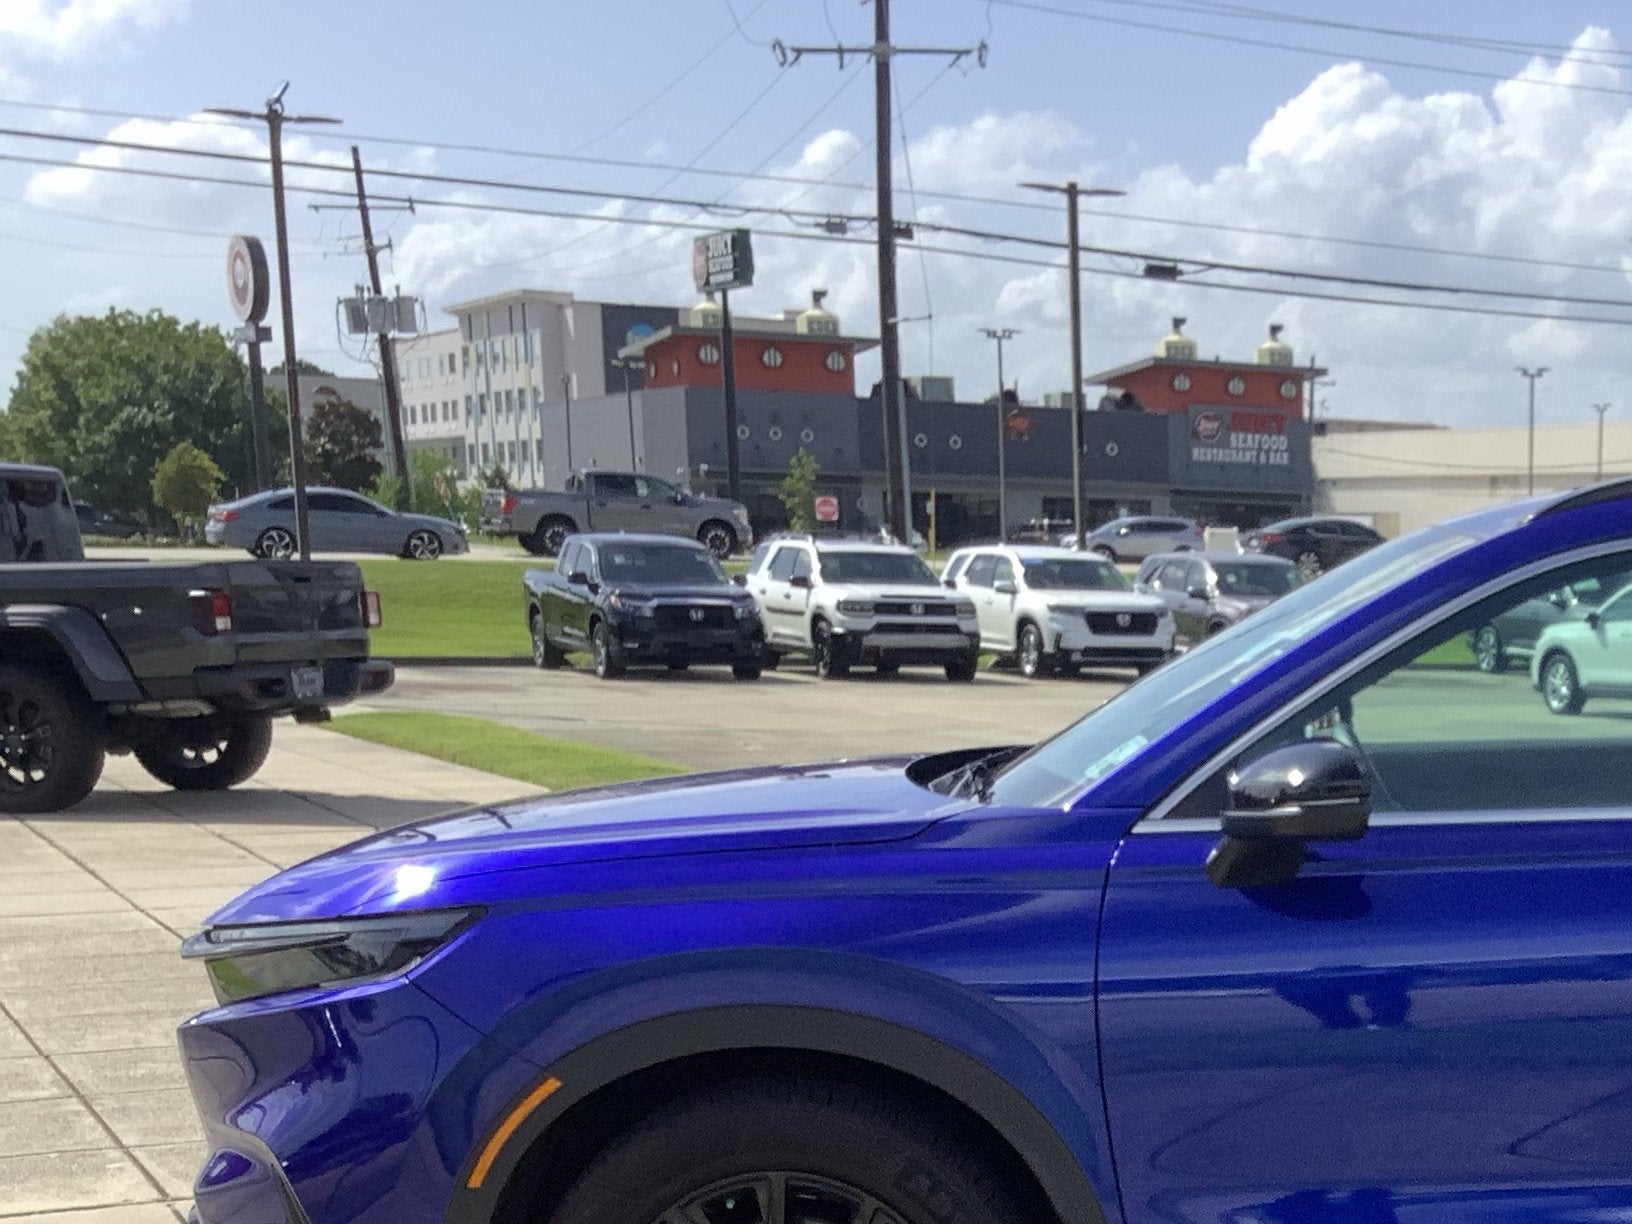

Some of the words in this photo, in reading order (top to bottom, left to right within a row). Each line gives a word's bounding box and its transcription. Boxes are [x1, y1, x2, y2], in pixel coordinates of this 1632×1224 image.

[1229, 432, 1289, 451] SEAFOOD
[1192, 447, 1258, 463] RESTAURANT
[1269, 451, 1290, 465] BAR
